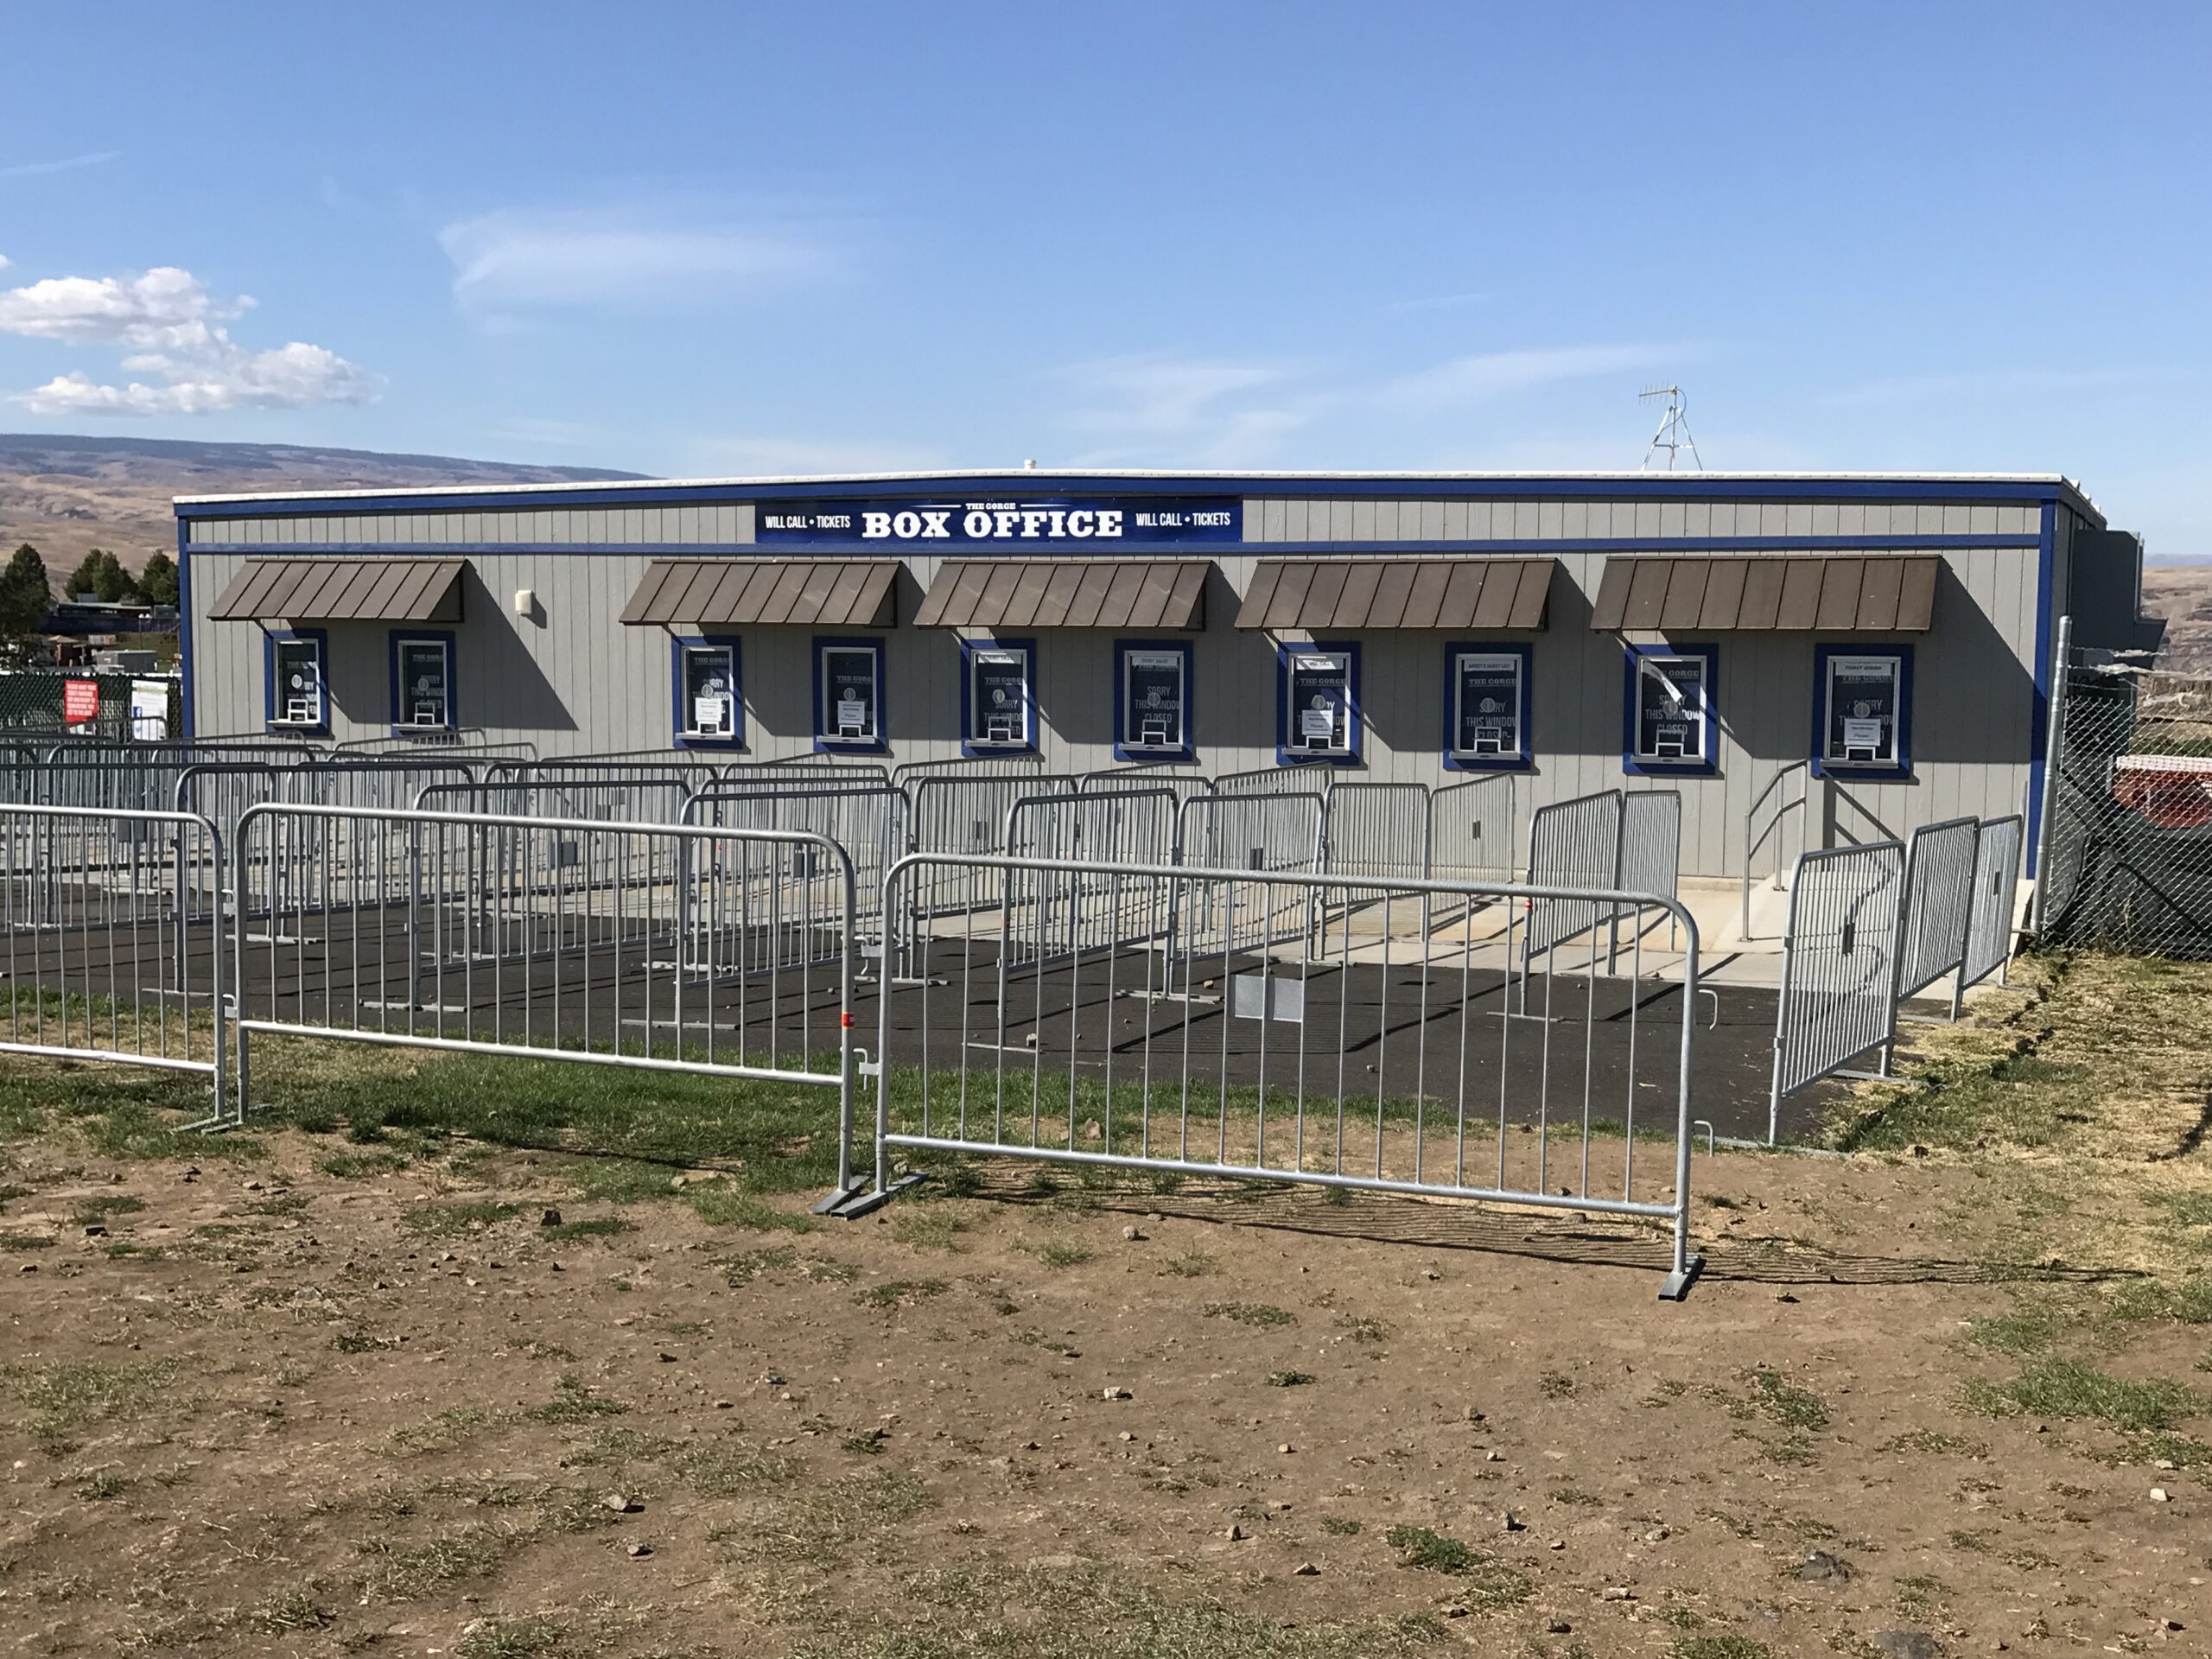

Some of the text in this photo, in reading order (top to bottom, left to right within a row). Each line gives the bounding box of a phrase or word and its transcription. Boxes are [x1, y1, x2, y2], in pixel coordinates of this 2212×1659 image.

[765, 515, 851, 528] WILL CALL TICKETS
[861, 511, 1122, 537] BOX OFFICE
[1135, 512, 1230, 526] WILL CALL TICKETS
[1479, 702, 1506, 713] SRY
[1645, 709, 1662, 720] THIS
[1465, 717, 1484, 727] THIS
